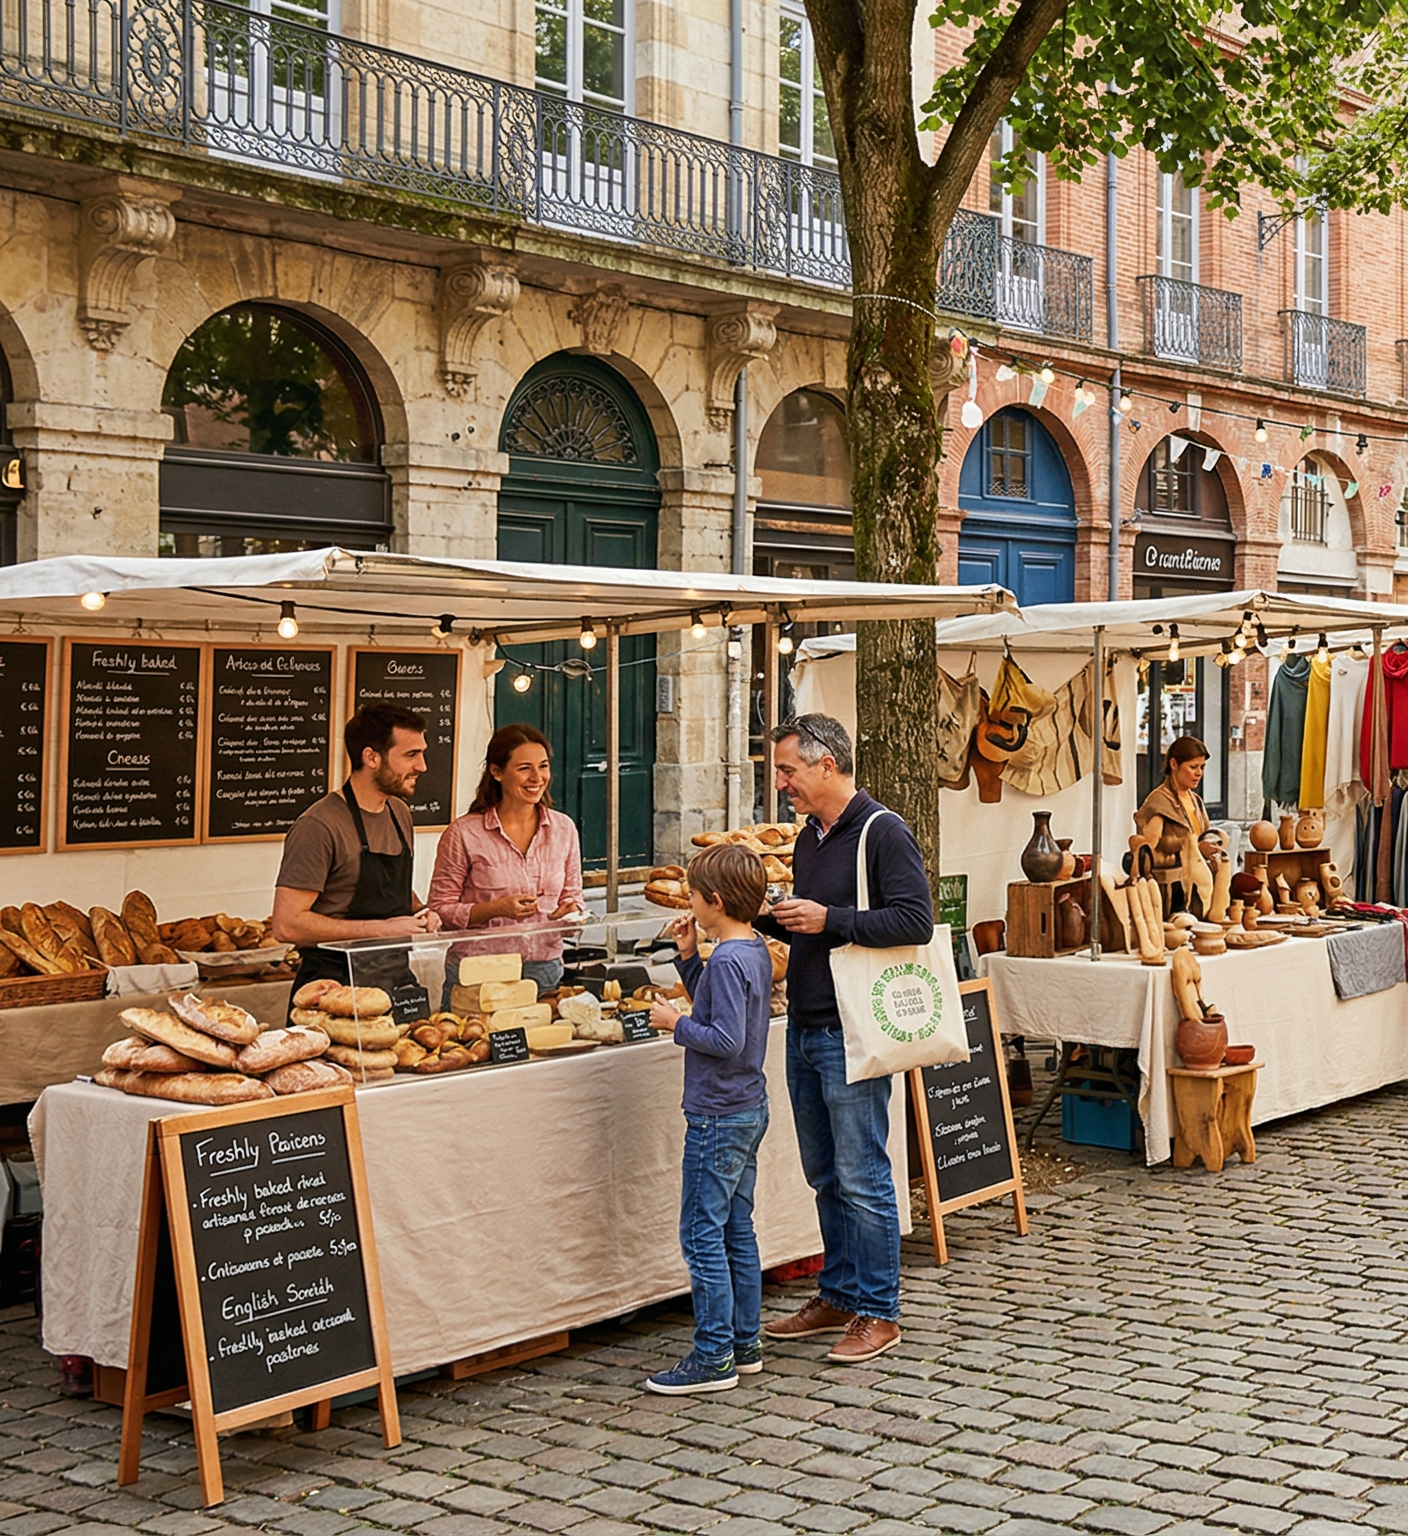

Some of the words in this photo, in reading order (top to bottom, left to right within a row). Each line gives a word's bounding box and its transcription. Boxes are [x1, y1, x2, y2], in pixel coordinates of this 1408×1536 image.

[92, 650, 136, 673] Freshly
[195, 1136, 259, 1167] Freshly
[199, 1185, 247, 1211] Freshly
[253, 1176, 294, 1199] baked
